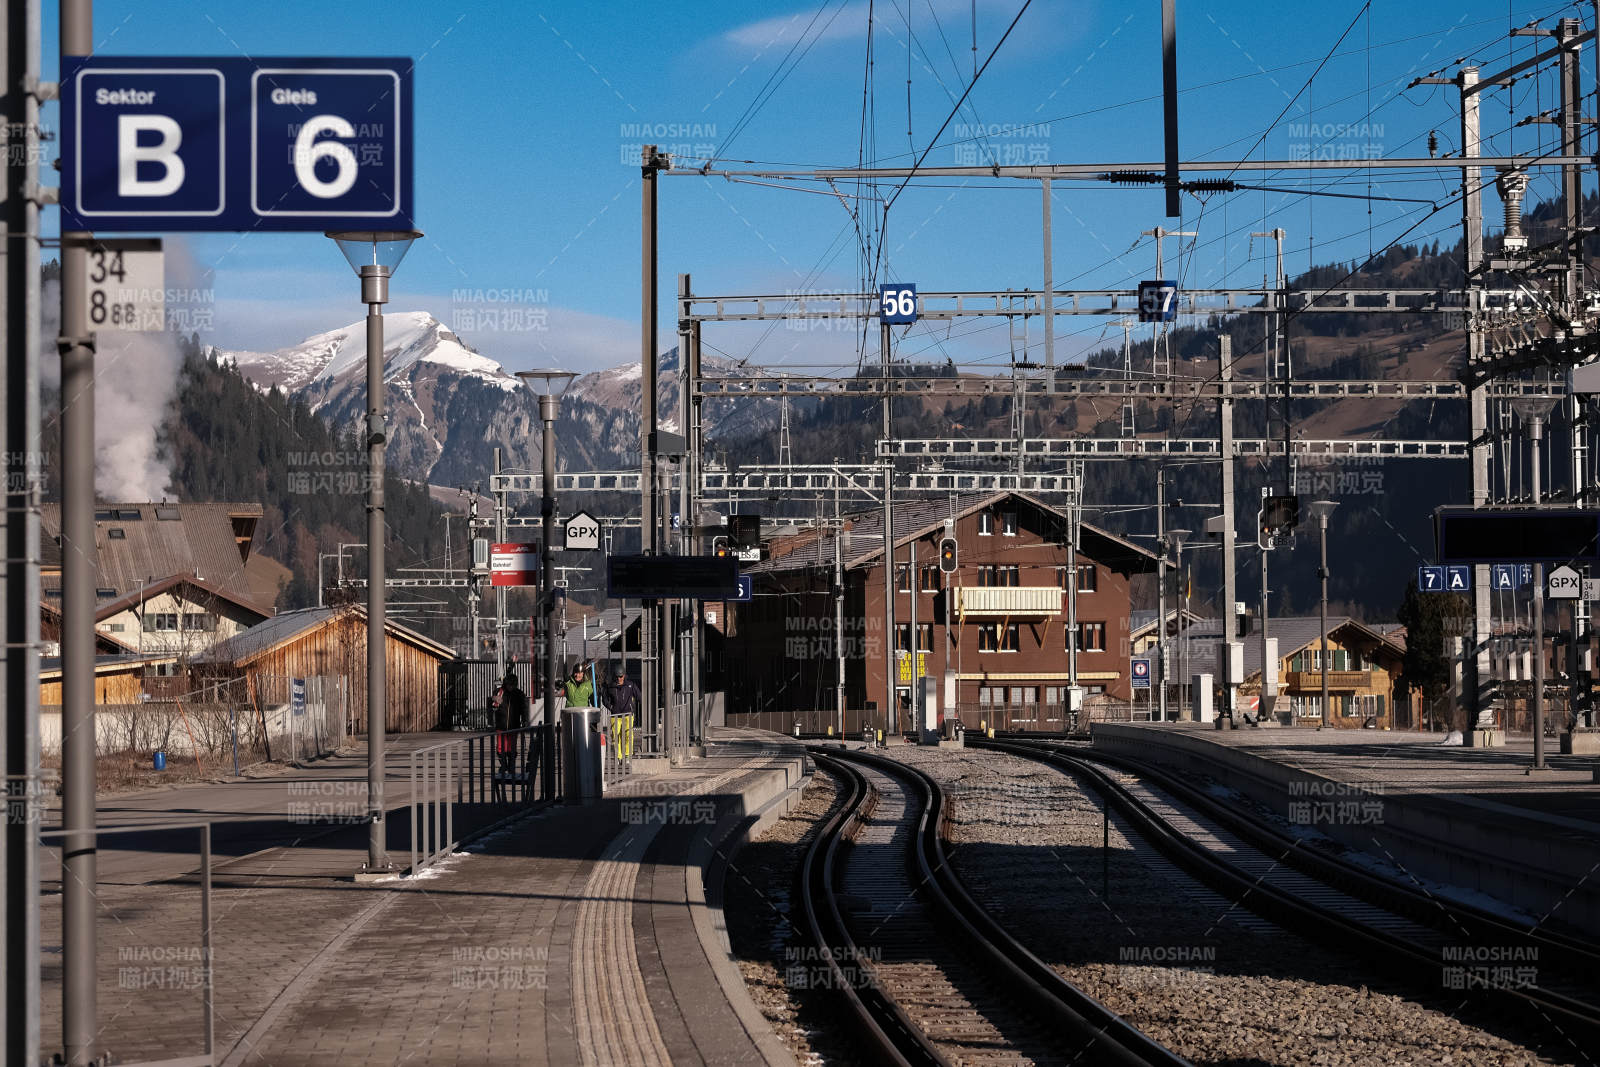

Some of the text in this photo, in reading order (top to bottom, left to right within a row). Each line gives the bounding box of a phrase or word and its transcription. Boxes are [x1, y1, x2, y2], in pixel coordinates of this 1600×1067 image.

[95, 88, 156, 105] Sektor
[271, 87, 317, 105] Gleis
[118, 114, 186, 197] B
[294, 114, 359, 199] 6
[90, 248, 126, 283] 34
[882, 289, 915, 316] 56
[1142, 286, 1176, 313] 57
[567, 526, 597, 538] GPX
[1425, 573, 1436, 588] 7
[1451, 573, 1464, 588] A
[1500, 572, 1511, 587] A
[1550, 577, 1578, 588] GPX
[1583, 581, 1593, 591] 34
